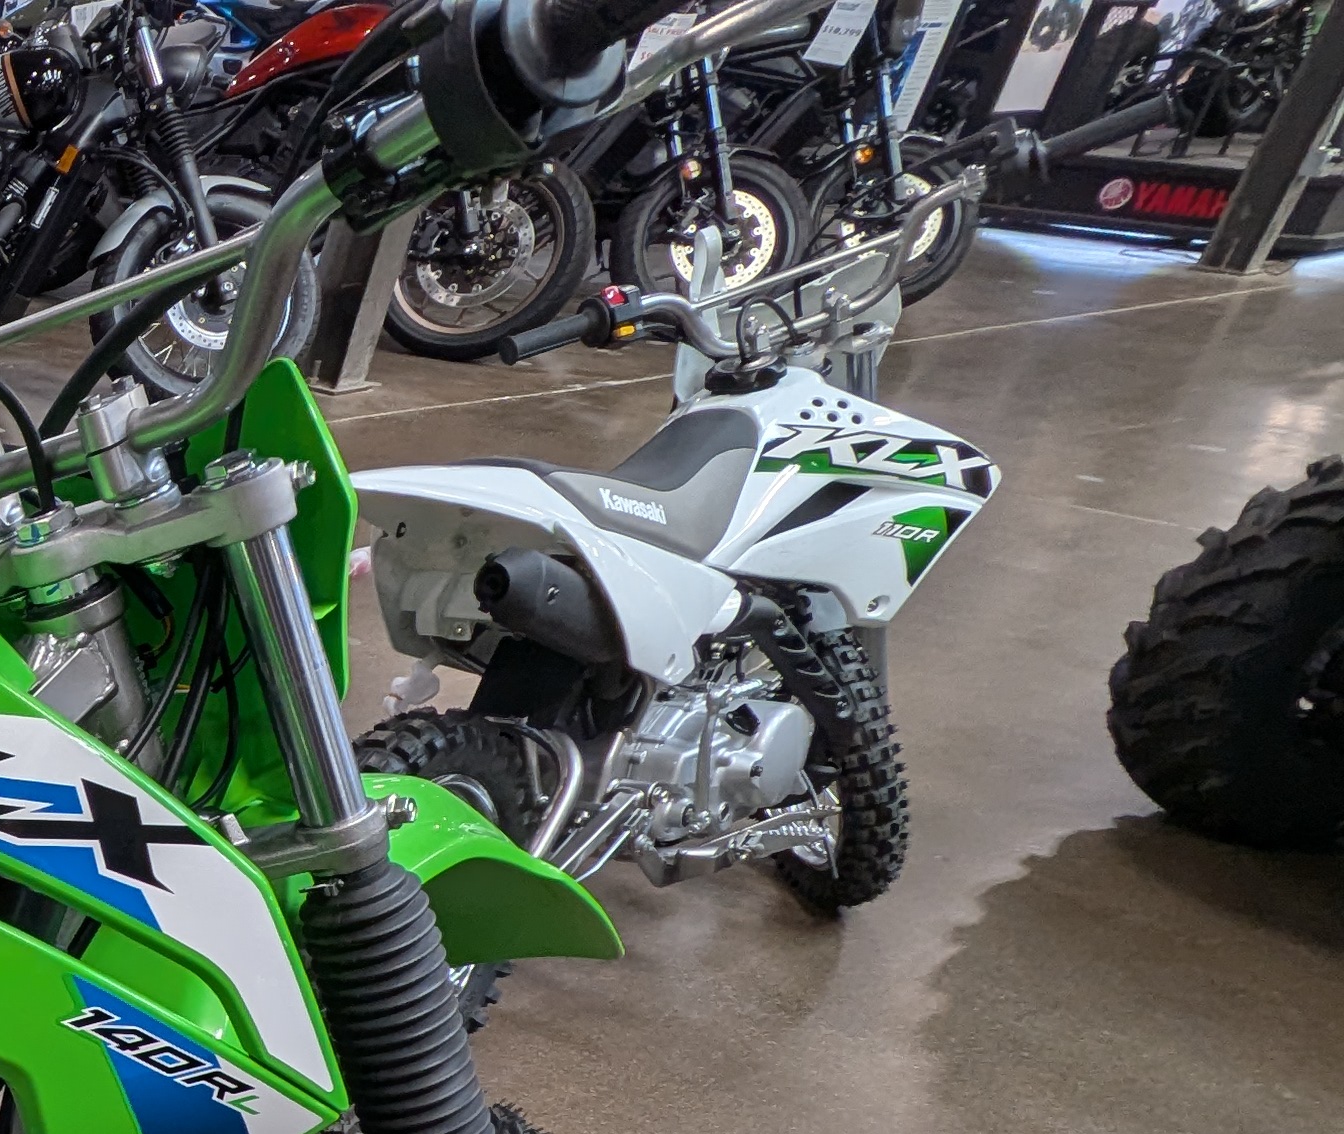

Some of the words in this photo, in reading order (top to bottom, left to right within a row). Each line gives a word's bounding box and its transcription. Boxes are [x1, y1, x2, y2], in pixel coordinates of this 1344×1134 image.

[1135, 181, 1230, 219] YAMAH
[762, 424, 992, 491] KLX
[598, 487, 667, 525] Kawasaki
[874, 521, 940, 543] 110R
